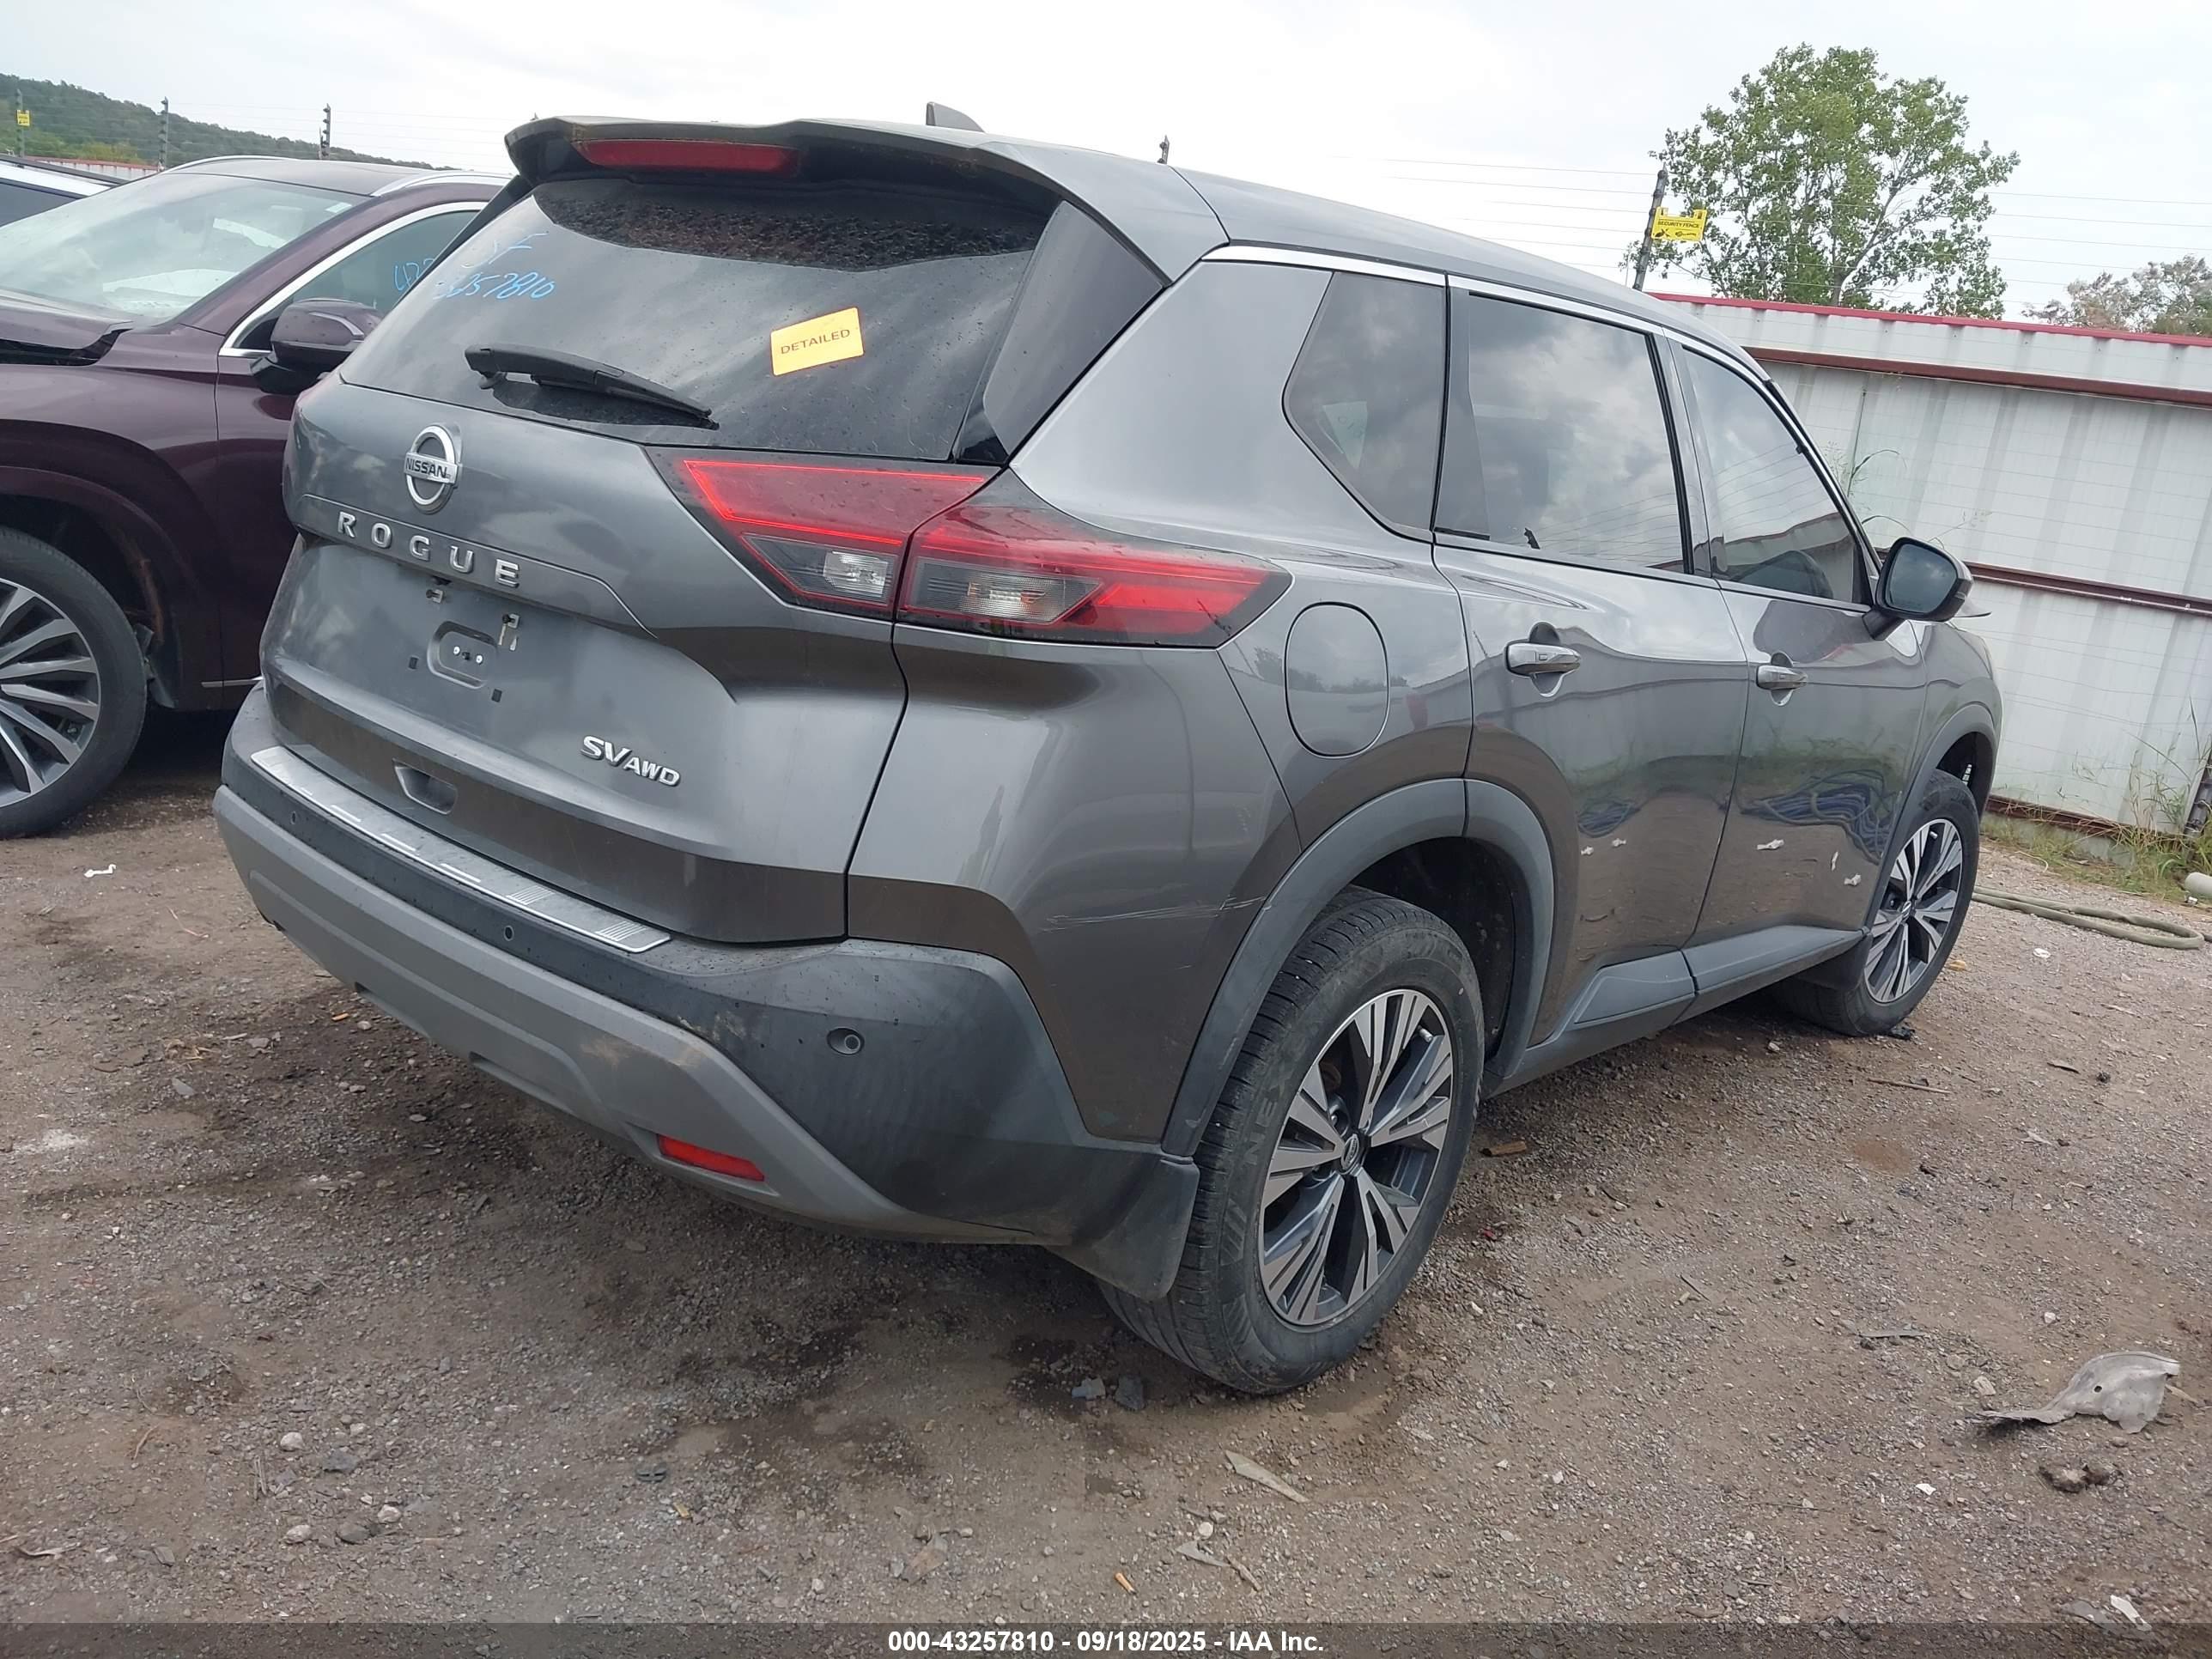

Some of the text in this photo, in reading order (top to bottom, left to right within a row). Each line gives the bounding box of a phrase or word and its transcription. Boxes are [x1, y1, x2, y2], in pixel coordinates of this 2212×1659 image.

[781, 329, 850, 354] DETAILED
[405, 458, 447, 479] NISSAN
[337, 511, 520, 588] ROGUE
